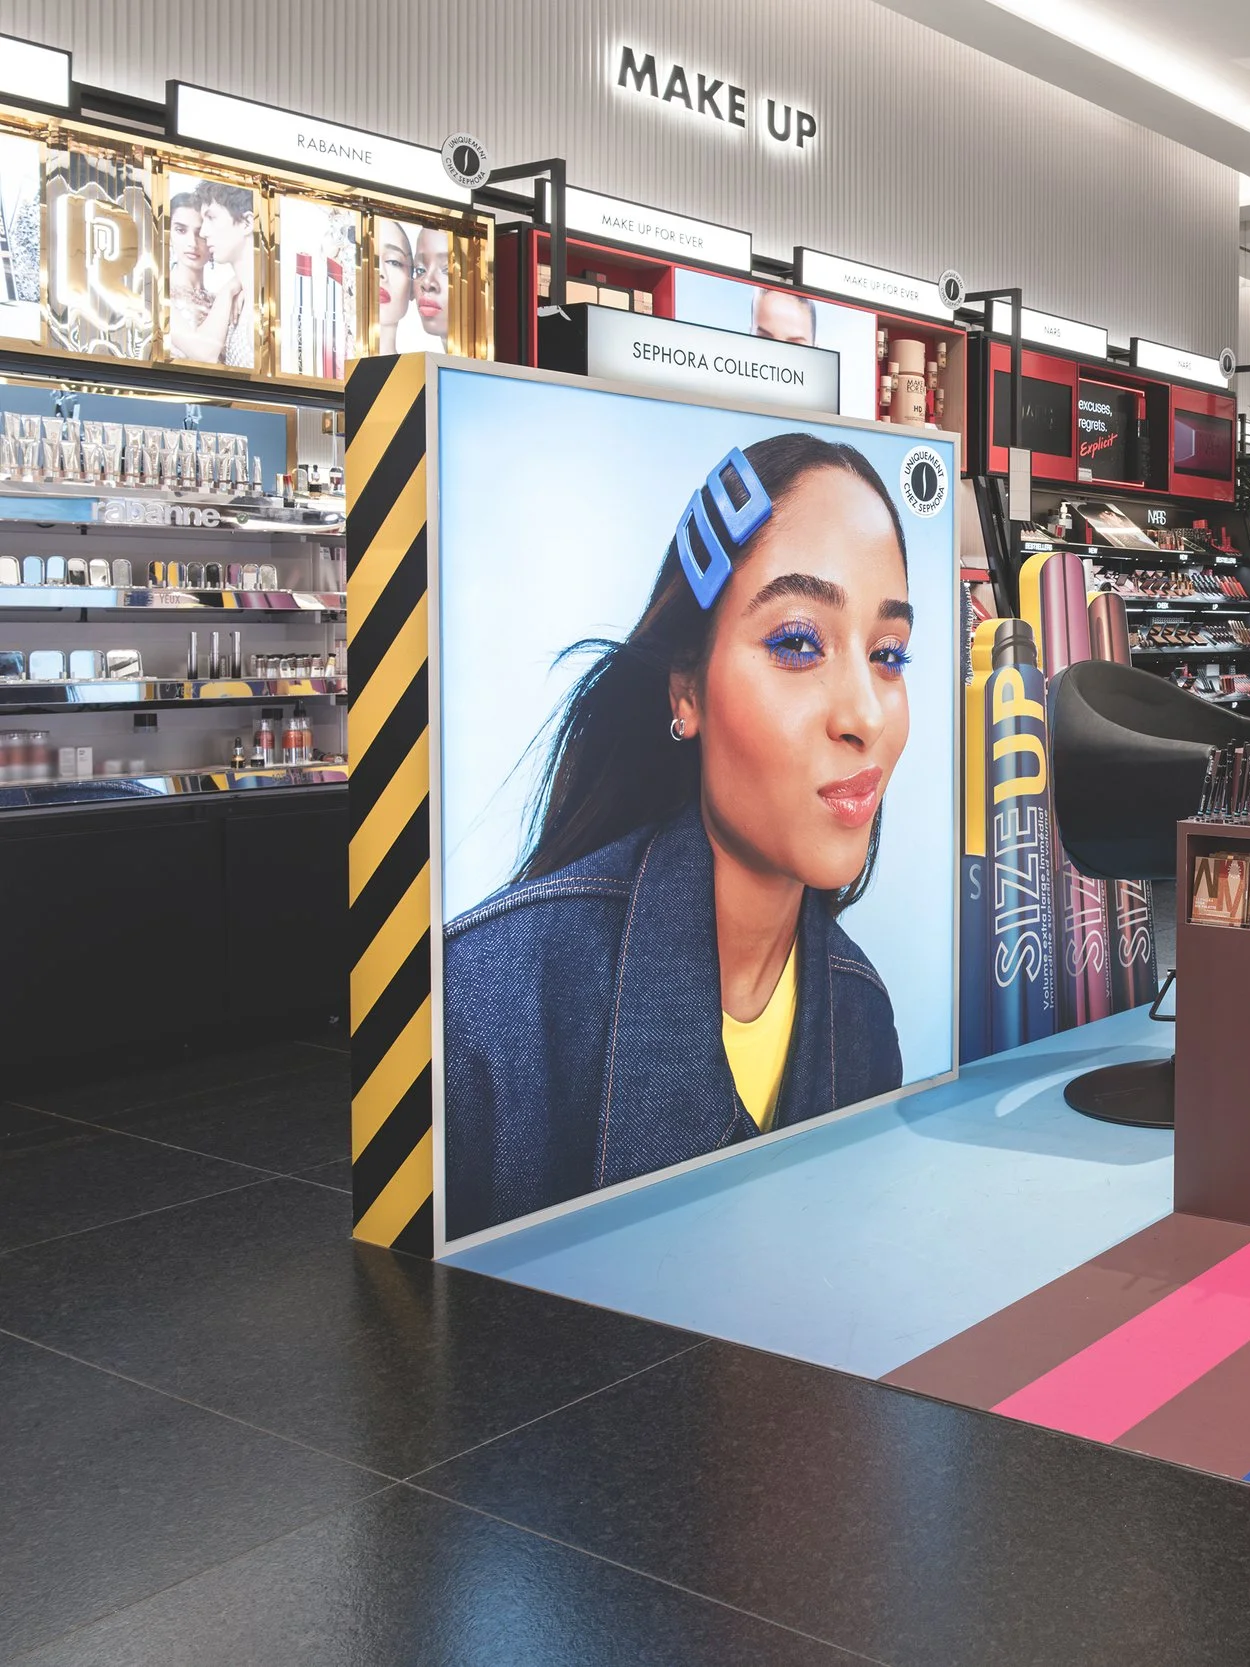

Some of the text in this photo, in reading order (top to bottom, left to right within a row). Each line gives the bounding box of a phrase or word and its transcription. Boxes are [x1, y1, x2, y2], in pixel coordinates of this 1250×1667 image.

[617, 45, 817, 149] MAKE UP
[297, 133, 353, 165] RABANNE
[448, 136, 487, 160] UNIQUEMENT
[445, 157, 486, 185] CHEZ SEPHORA
[601, 214, 704, 248] MAKE UP FOR EVER
[843, 274, 919, 302] MAKE UP FOR EVER
[1043, 326, 1062, 338] NARS
[632, 341, 805, 387] SEPHORA COLLECTION
[914, 405, 923, 413] HD
[1078, 399, 1113, 417] excuses,
[1078, 417, 1108, 434] regrets.
[1080, 432, 1119, 459] Explicit
[904, 451, 945, 477] UNIQUEMENT
[903, 482, 945, 513] CHEZ SEPHORA
[91, 499, 221, 528] rabanne
[1147, 509, 1167, 526] NARS
[159, 595, 181, 604] YEUX
[993, 667, 1047, 805] UP
[1037, 806, 1046, 870] immédiat
[1042, 809, 1050, 855] volume
[993, 805, 1043, 988] SIZE
[1039, 873, 1047, 909] large
[1062, 850, 1105, 978] SIZ
